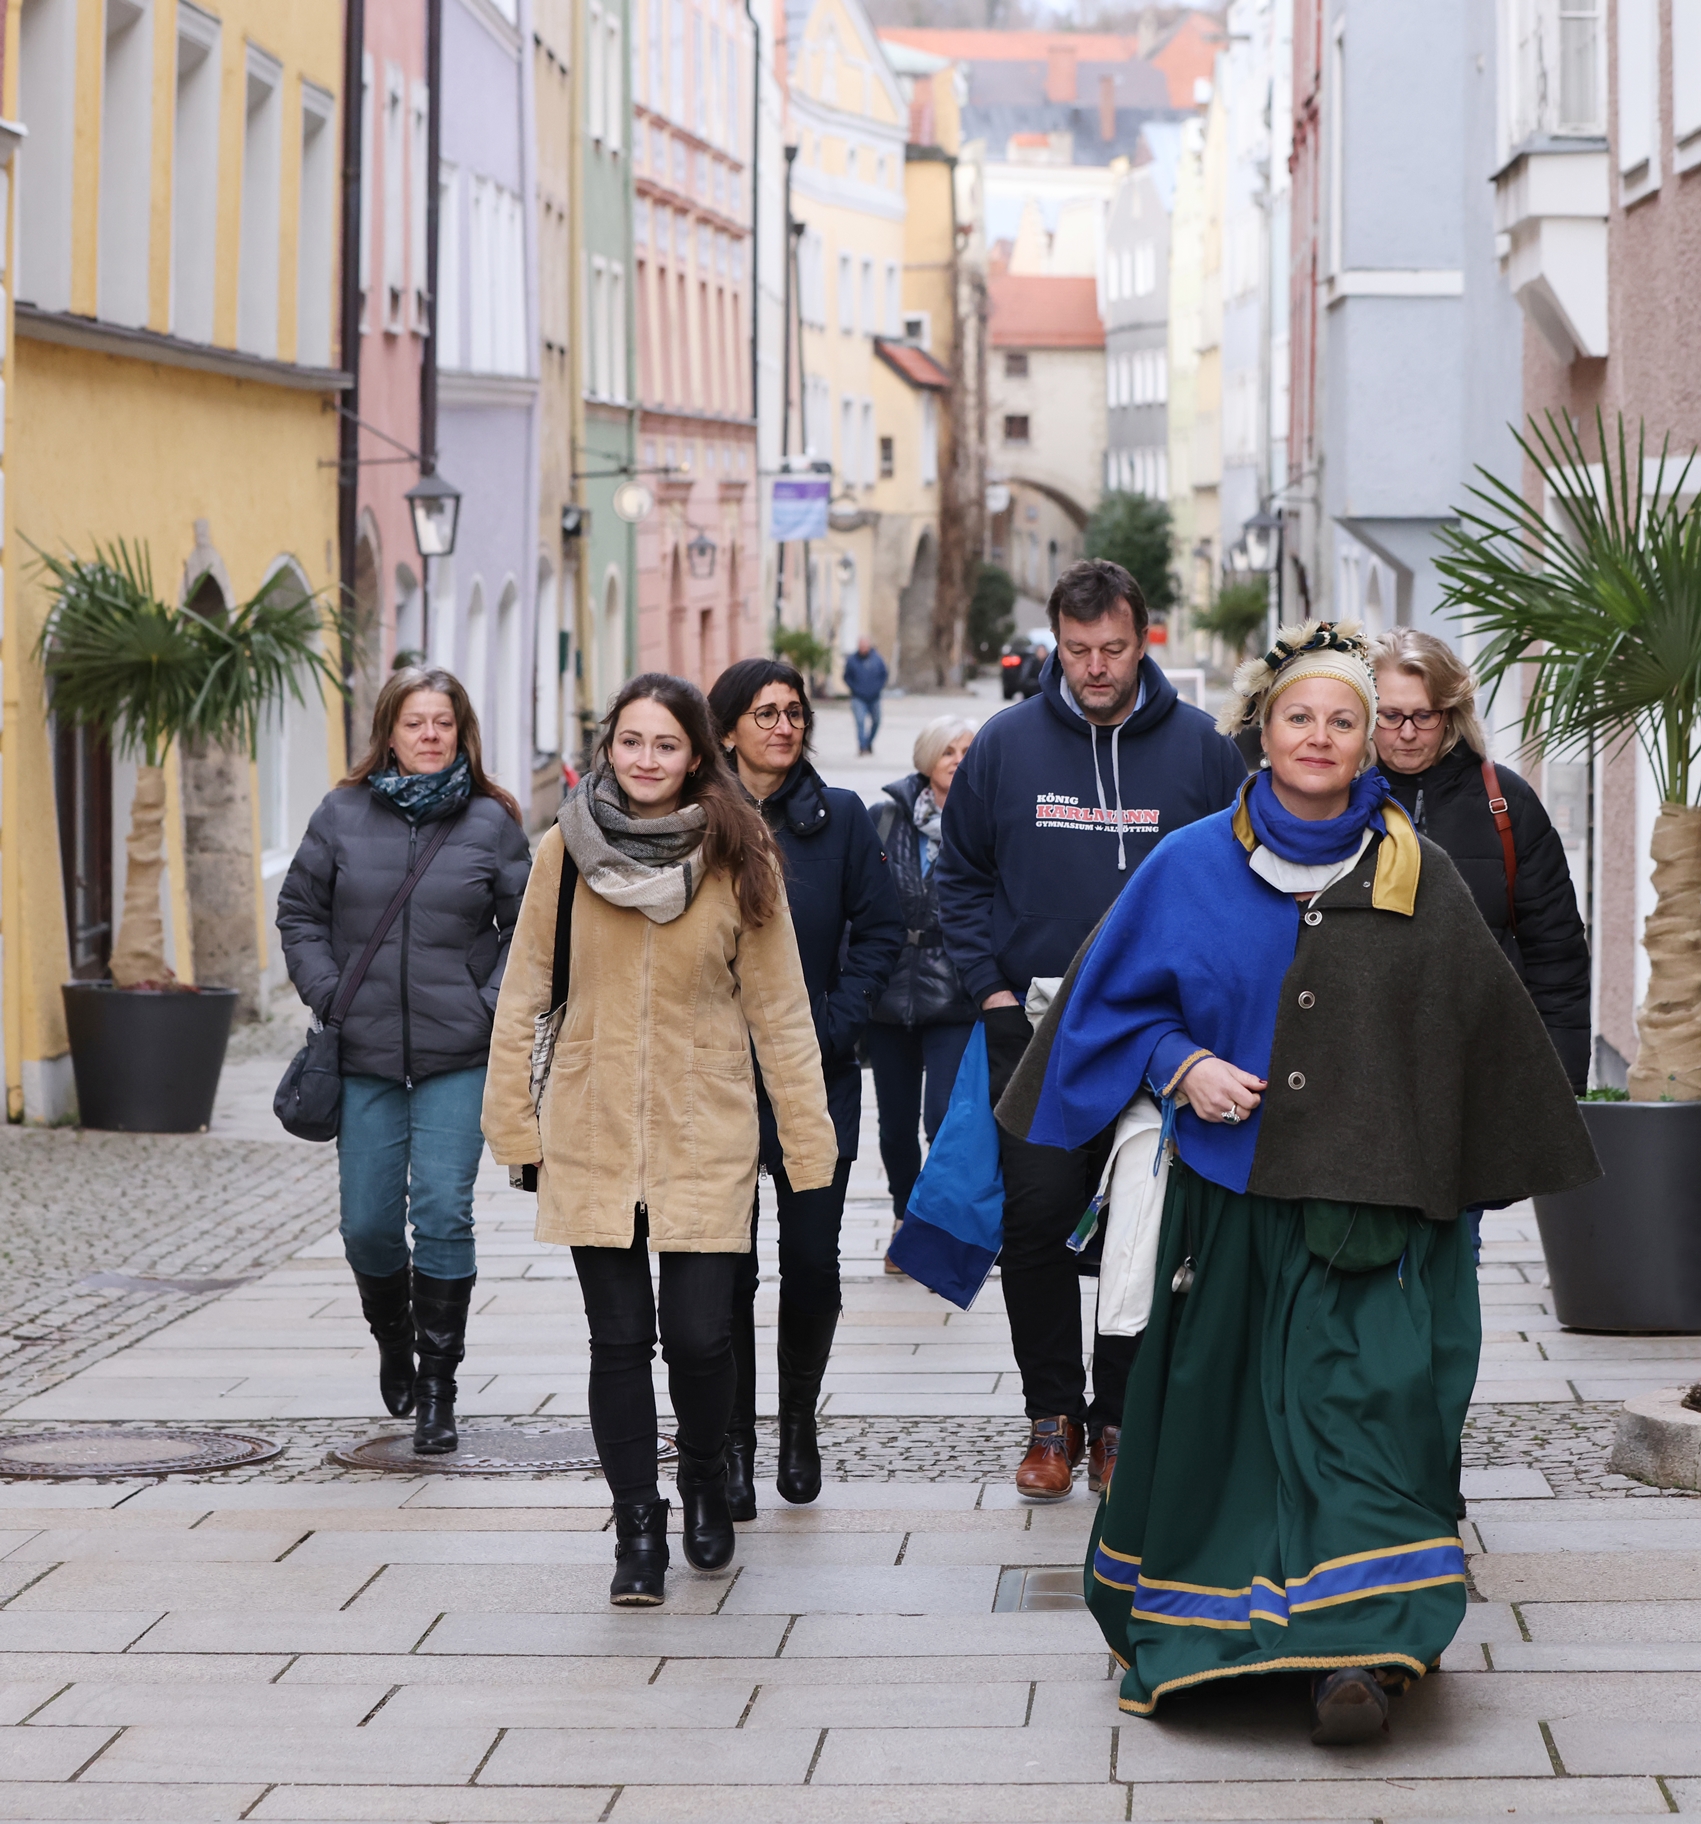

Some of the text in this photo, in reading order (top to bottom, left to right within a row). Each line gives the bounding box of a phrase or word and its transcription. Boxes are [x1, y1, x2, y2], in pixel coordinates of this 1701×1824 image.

[1036, 792, 1079, 805] KÖNIG
[1036, 804, 1160, 824] KARLMANN
[1035, 820, 1160, 833] GYMNASIUM ALÖTTING
